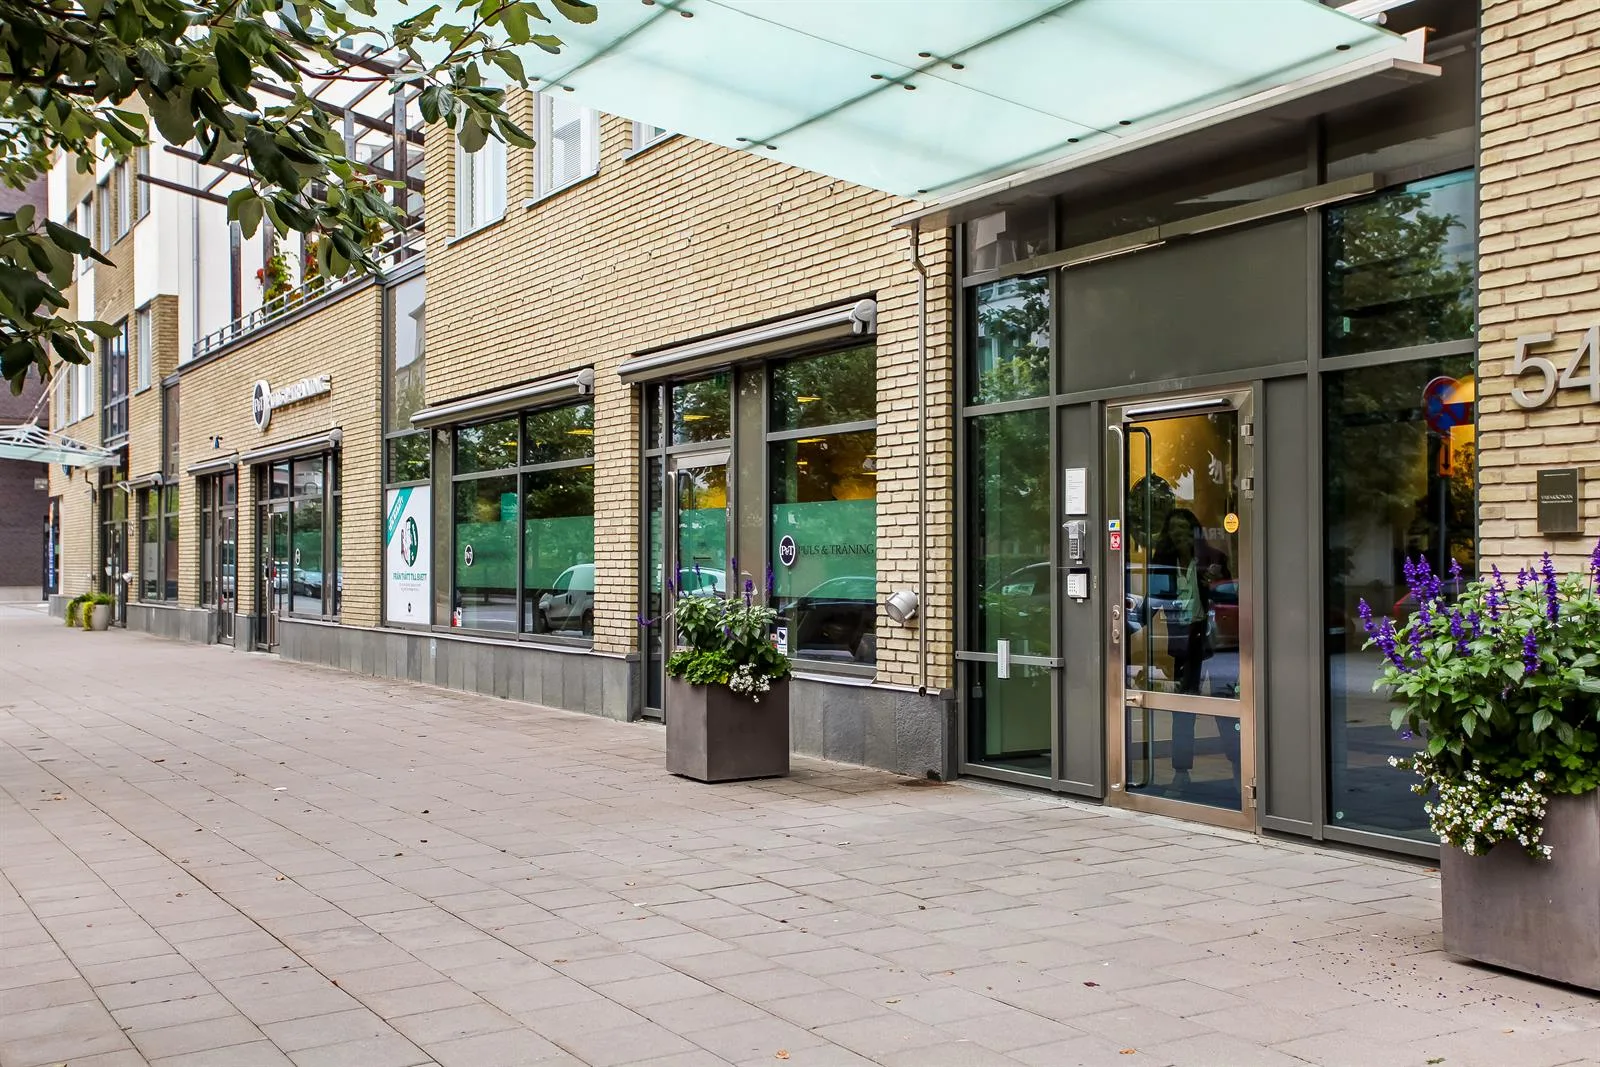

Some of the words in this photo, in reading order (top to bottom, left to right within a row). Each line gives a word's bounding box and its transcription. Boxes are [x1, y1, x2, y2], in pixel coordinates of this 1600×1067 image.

[1511, 325, 1600, 410] 54
[780, 545, 795, 556] P&T
[798, 543, 820, 556] PULS
[821, 544, 829, 556] &
[829, 542, 874, 555] TRÄNING
